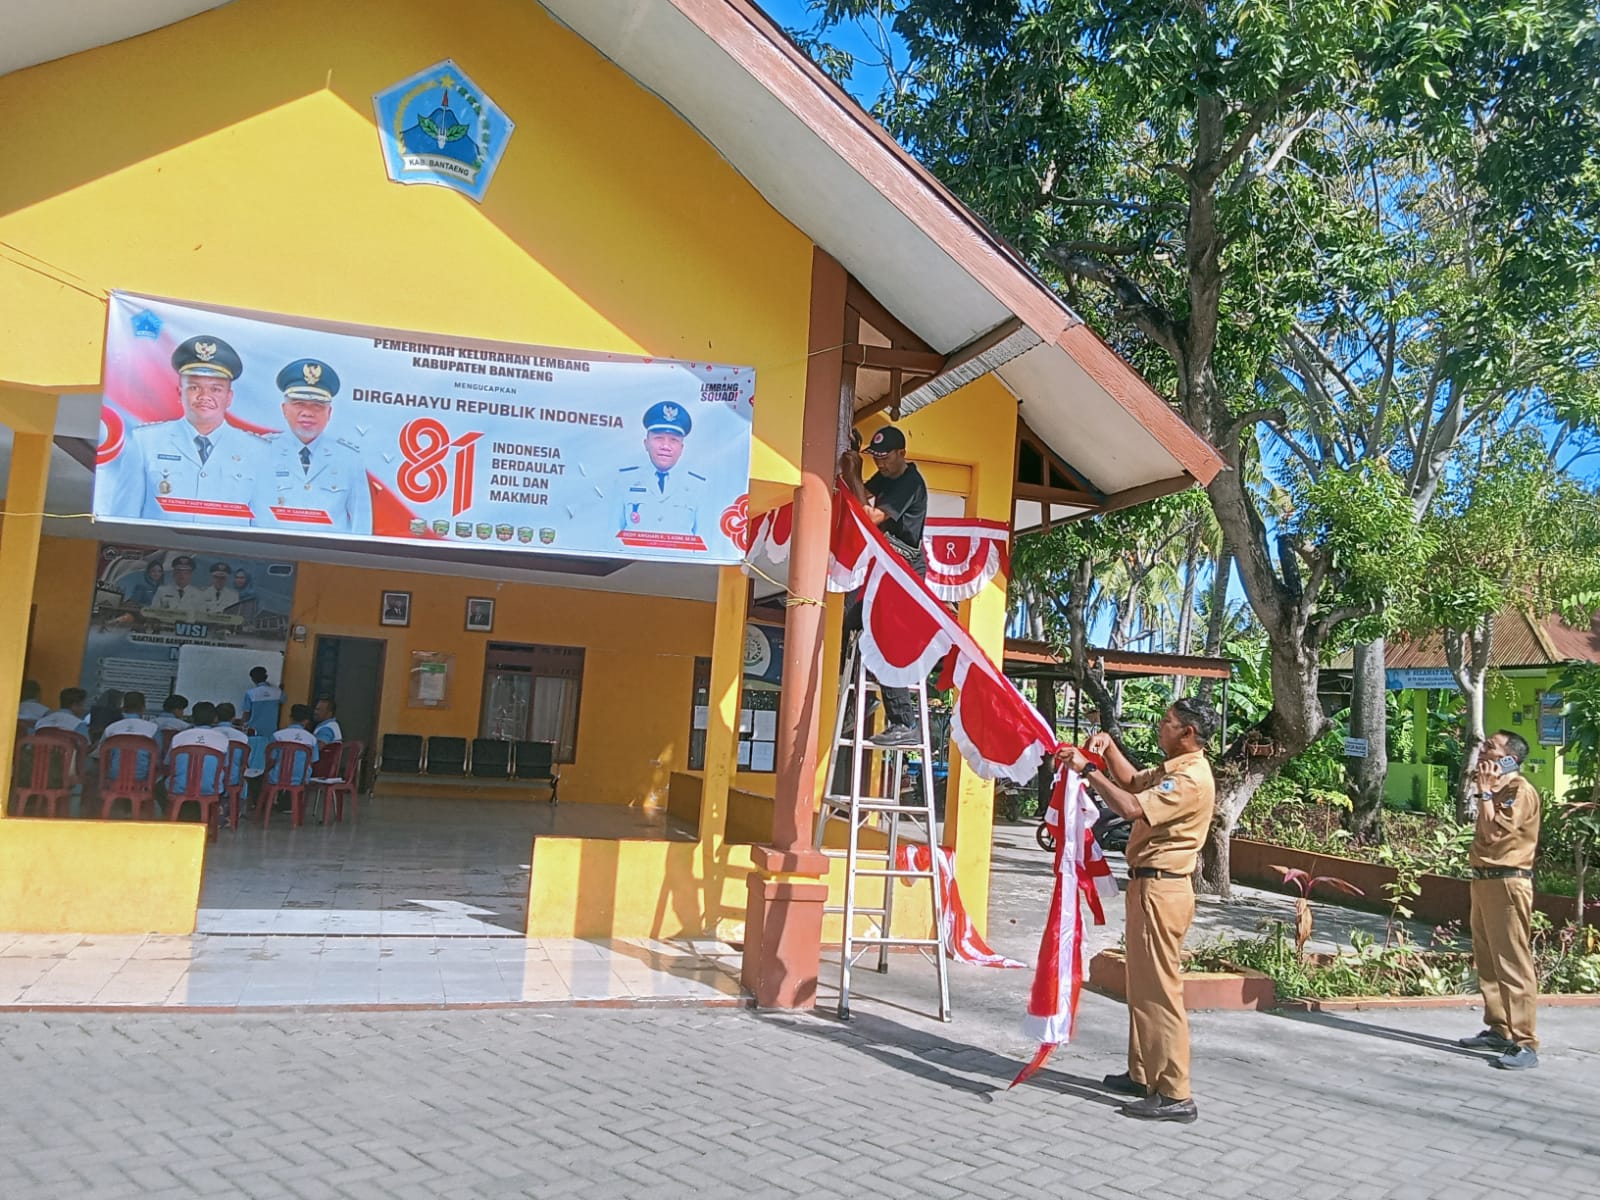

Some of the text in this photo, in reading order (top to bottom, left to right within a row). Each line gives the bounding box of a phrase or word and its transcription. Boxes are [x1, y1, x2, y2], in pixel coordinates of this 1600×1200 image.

[429, 159, 470, 177] BANTAENG
[373, 338, 590, 372] PEMERINTAH KELURAHAN LEMBANG
[412, 356, 553, 382] KABUPATEN BANTAENG
[454, 381, 517, 394] MENGUCAPKAN
[700, 383, 739, 392] LEMBANG
[700, 391, 739, 402] SQUAD!
[352, 388, 624, 429] DIRGAHAYU REPUBLIK INDONESIA
[492, 441, 562, 460] INDONESIA
[396, 417, 485, 518] 81
[491, 458, 565, 476] BERDAULAT
[490, 474, 549, 490] ADIL DAN
[489, 490, 549, 506] MAKMUR
[176, 623, 208, 637] VISI
